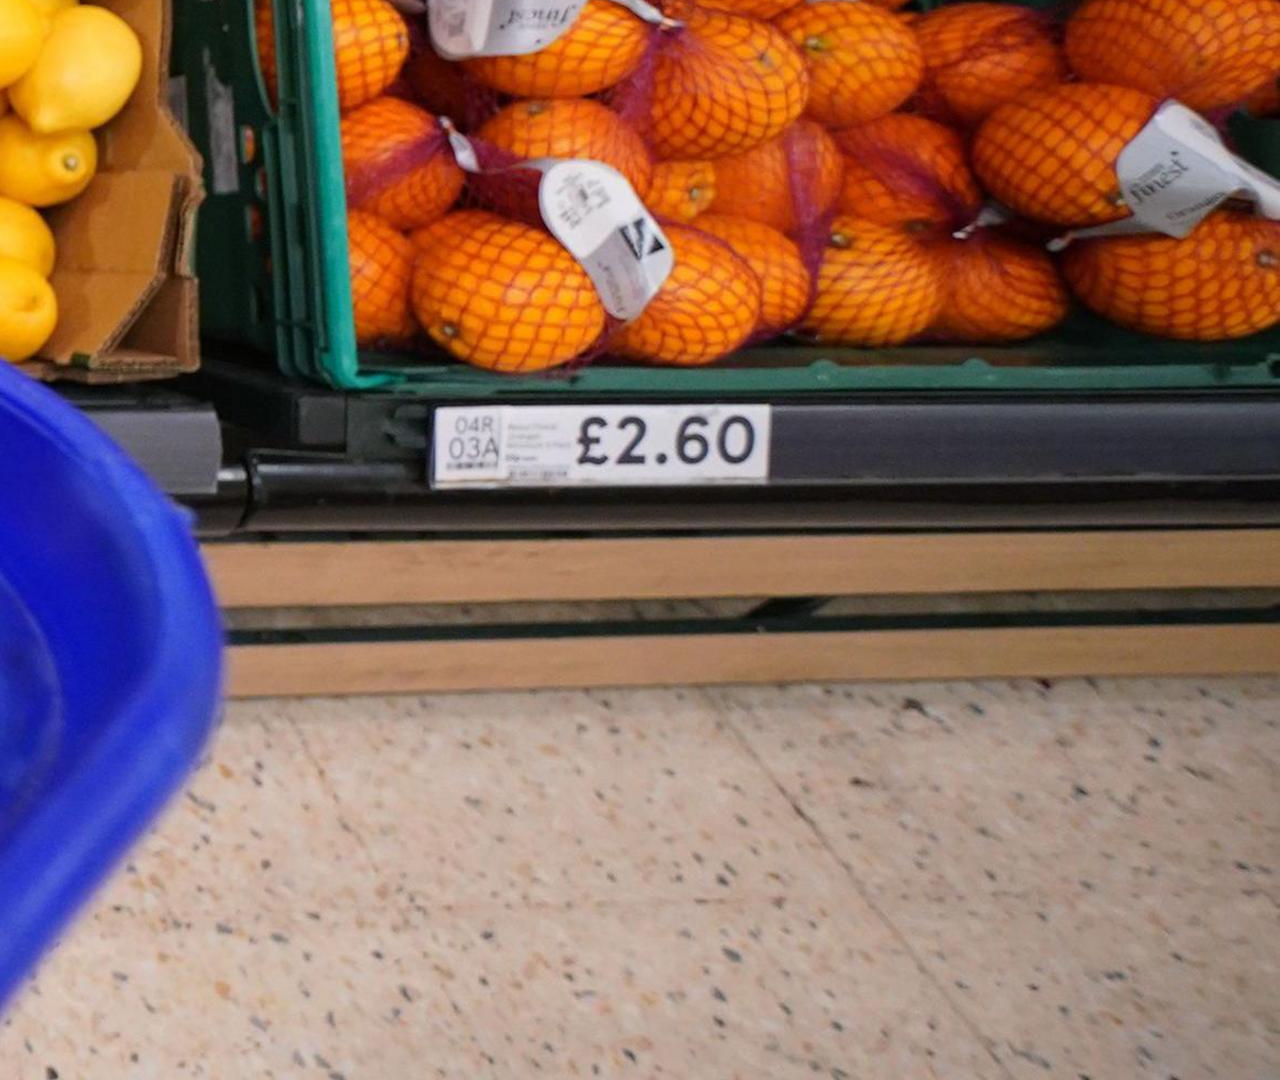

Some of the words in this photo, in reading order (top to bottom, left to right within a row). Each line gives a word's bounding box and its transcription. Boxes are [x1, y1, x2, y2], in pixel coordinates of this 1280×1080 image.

[1129, 159, 1189, 202] finest
[448, 437, 499, 460] 03A
[577, 415, 756, 465] £2.60
